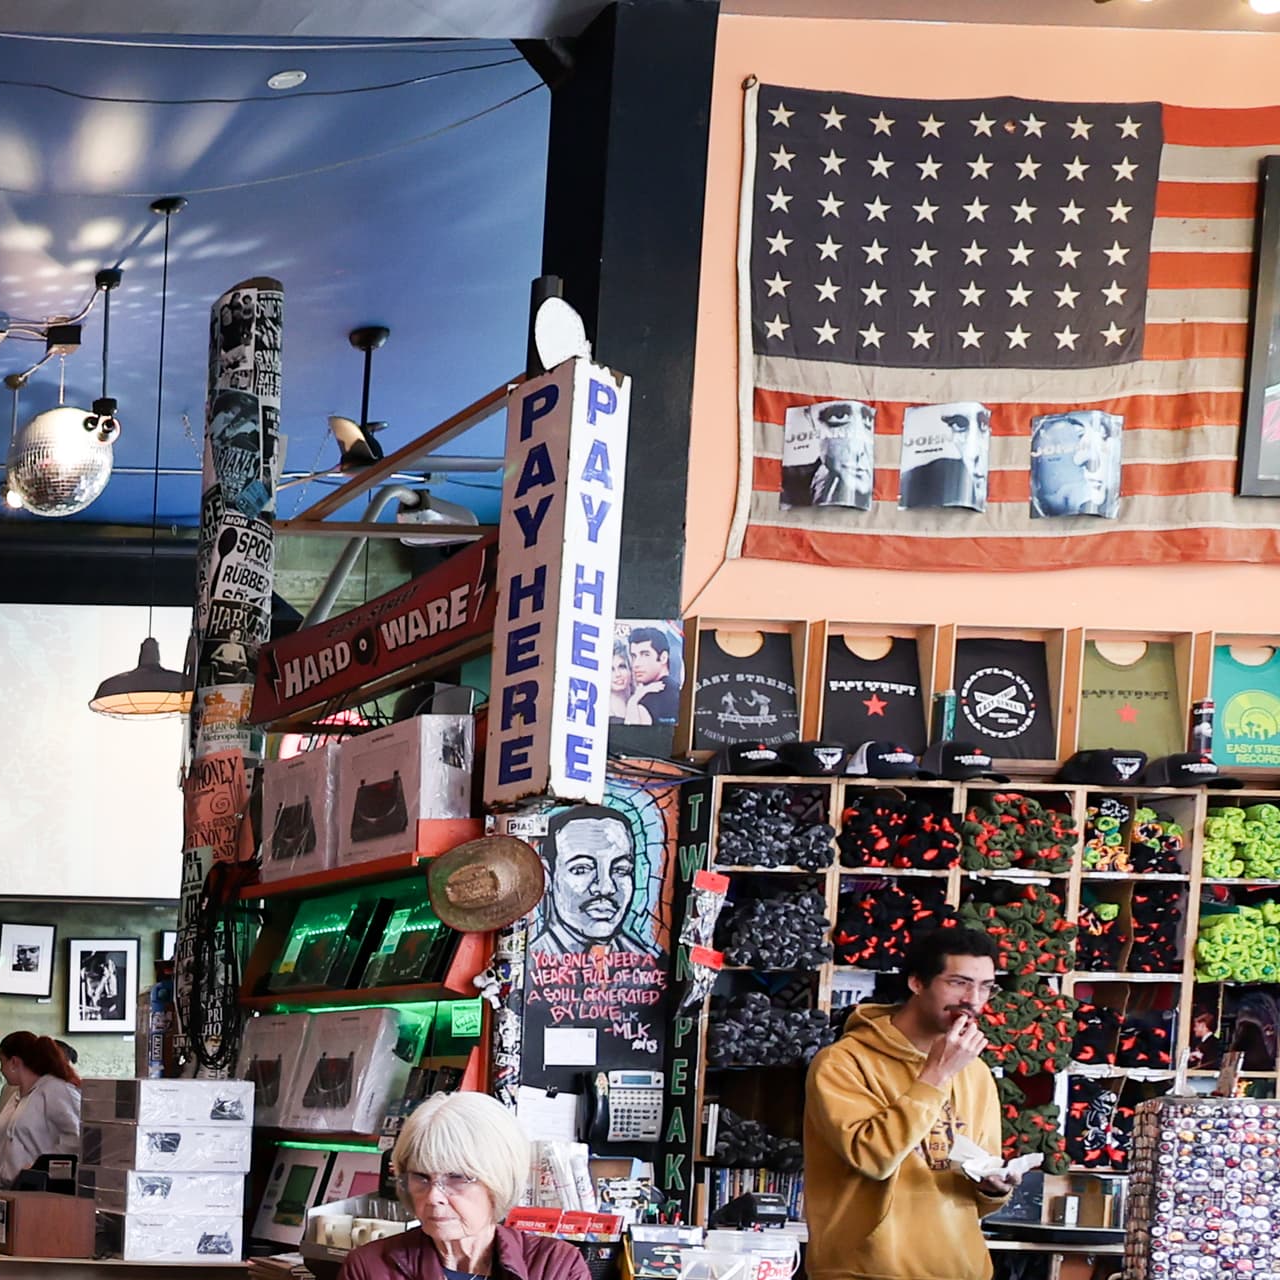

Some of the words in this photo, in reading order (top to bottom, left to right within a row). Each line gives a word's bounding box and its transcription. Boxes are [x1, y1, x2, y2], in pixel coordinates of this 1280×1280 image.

[513, 384, 559, 548] PAY
[580, 377, 617, 543] PAY
[284, 641, 351, 699] HARD
[380, 584, 469, 650] WARE
[498, 564, 547, 786] HERE
[564, 563, 605, 783] HERE
[695, 673, 730, 692] EASY
[736, 673, 796, 695] STREET
[829, 680, 864, 693] EASY
[865, 680, 918, 697] STREET
[1226, 744, 1256, 755] EASY
[532, 952, 557, 968] YOU
[562, 952, 597, 967] ONLY
[603, 952, 637, 967] NEED
[642, 953, 656, 966] A
[530, 967, 578, 987] HEART
[583, 969, 611, 985] FULL
[614, 970, 631, 983] OF
[543, 988, 580, 1003] SOUL
[583, 988, 660, 1005] GENERATED
[550, 1006, 575, 1023] BY
[579, 1005, 622, 1021] LOVE
